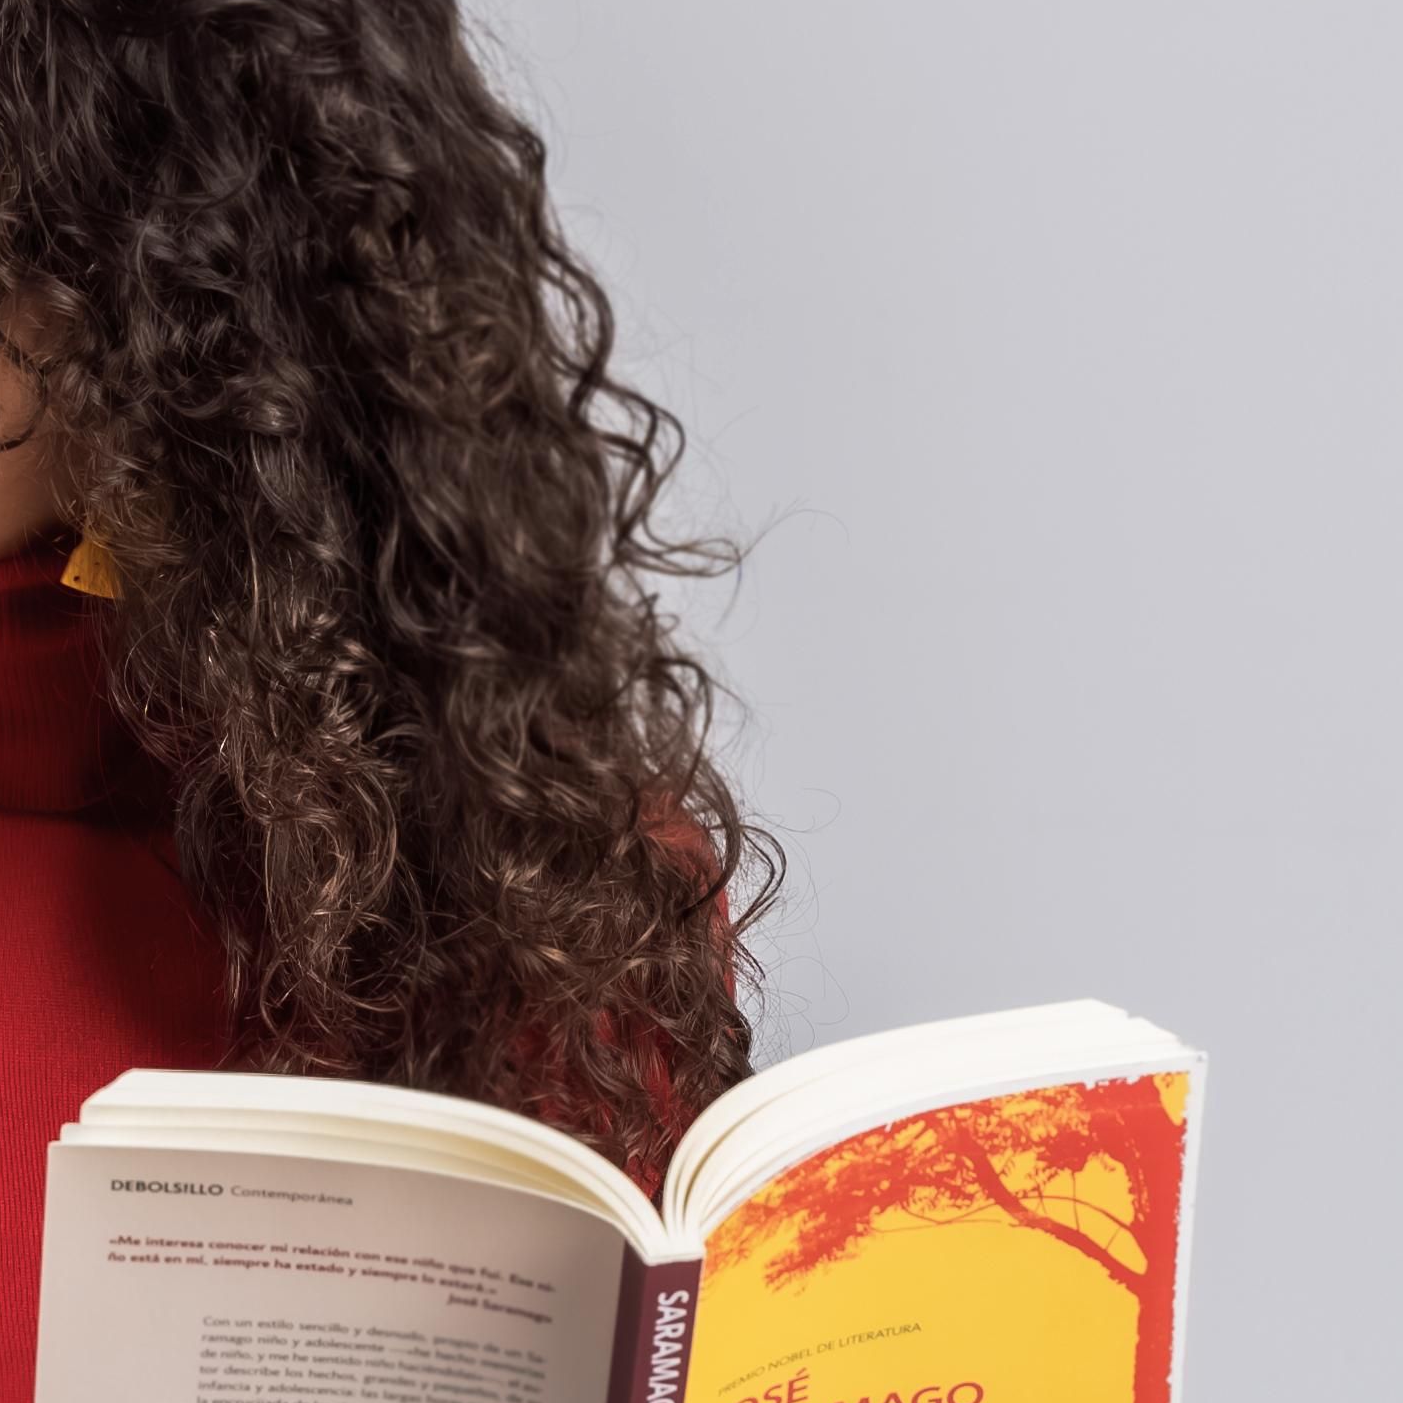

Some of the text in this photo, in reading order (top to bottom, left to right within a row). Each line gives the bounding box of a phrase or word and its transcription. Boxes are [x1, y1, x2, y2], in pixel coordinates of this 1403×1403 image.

[110, 1179, 354, 1206] DEBOLSILLO Contemporánea
[145, 1236, 204, 1249] interesa
[208, 1241, 266, 1251] conocer
[270, 1242, 288, 1253] mi
[292, 1243, 350, 1258] relación
[108, 1251, 126, 1262] ño
[130, 1252, 160, 1263] está
[164, 1255, 182, 1264] en
[186, 1254, 206, 1266] mí,
[213, 1255, 270, 1271] siempre
[274, 1258, 290, 1270] ha
[296, 1261, 344, 1274] estado
[349, 1266, 356, 1278] y
[718, 1322, 922, 1398] PREMIO NOBEL DE LITERATURA
